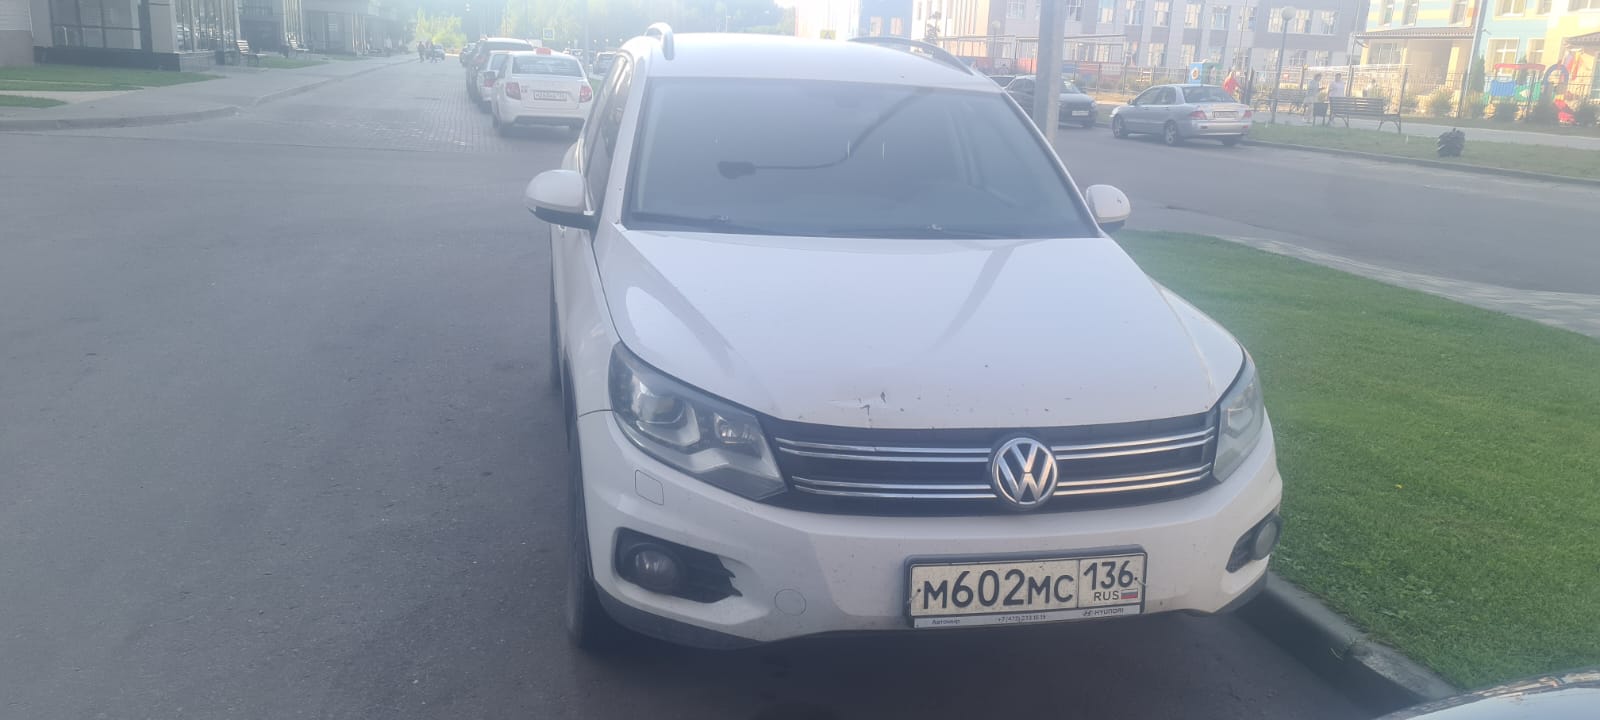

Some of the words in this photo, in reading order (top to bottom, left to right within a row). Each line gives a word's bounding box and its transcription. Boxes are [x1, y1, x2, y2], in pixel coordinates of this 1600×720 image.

[994, 438, 1056, 504] VW
[1083, 560, 1134, 590] 136
[1093, 590, 1120, 601] RUS
[1094, 607, 1125, 617] HYUNDAI
